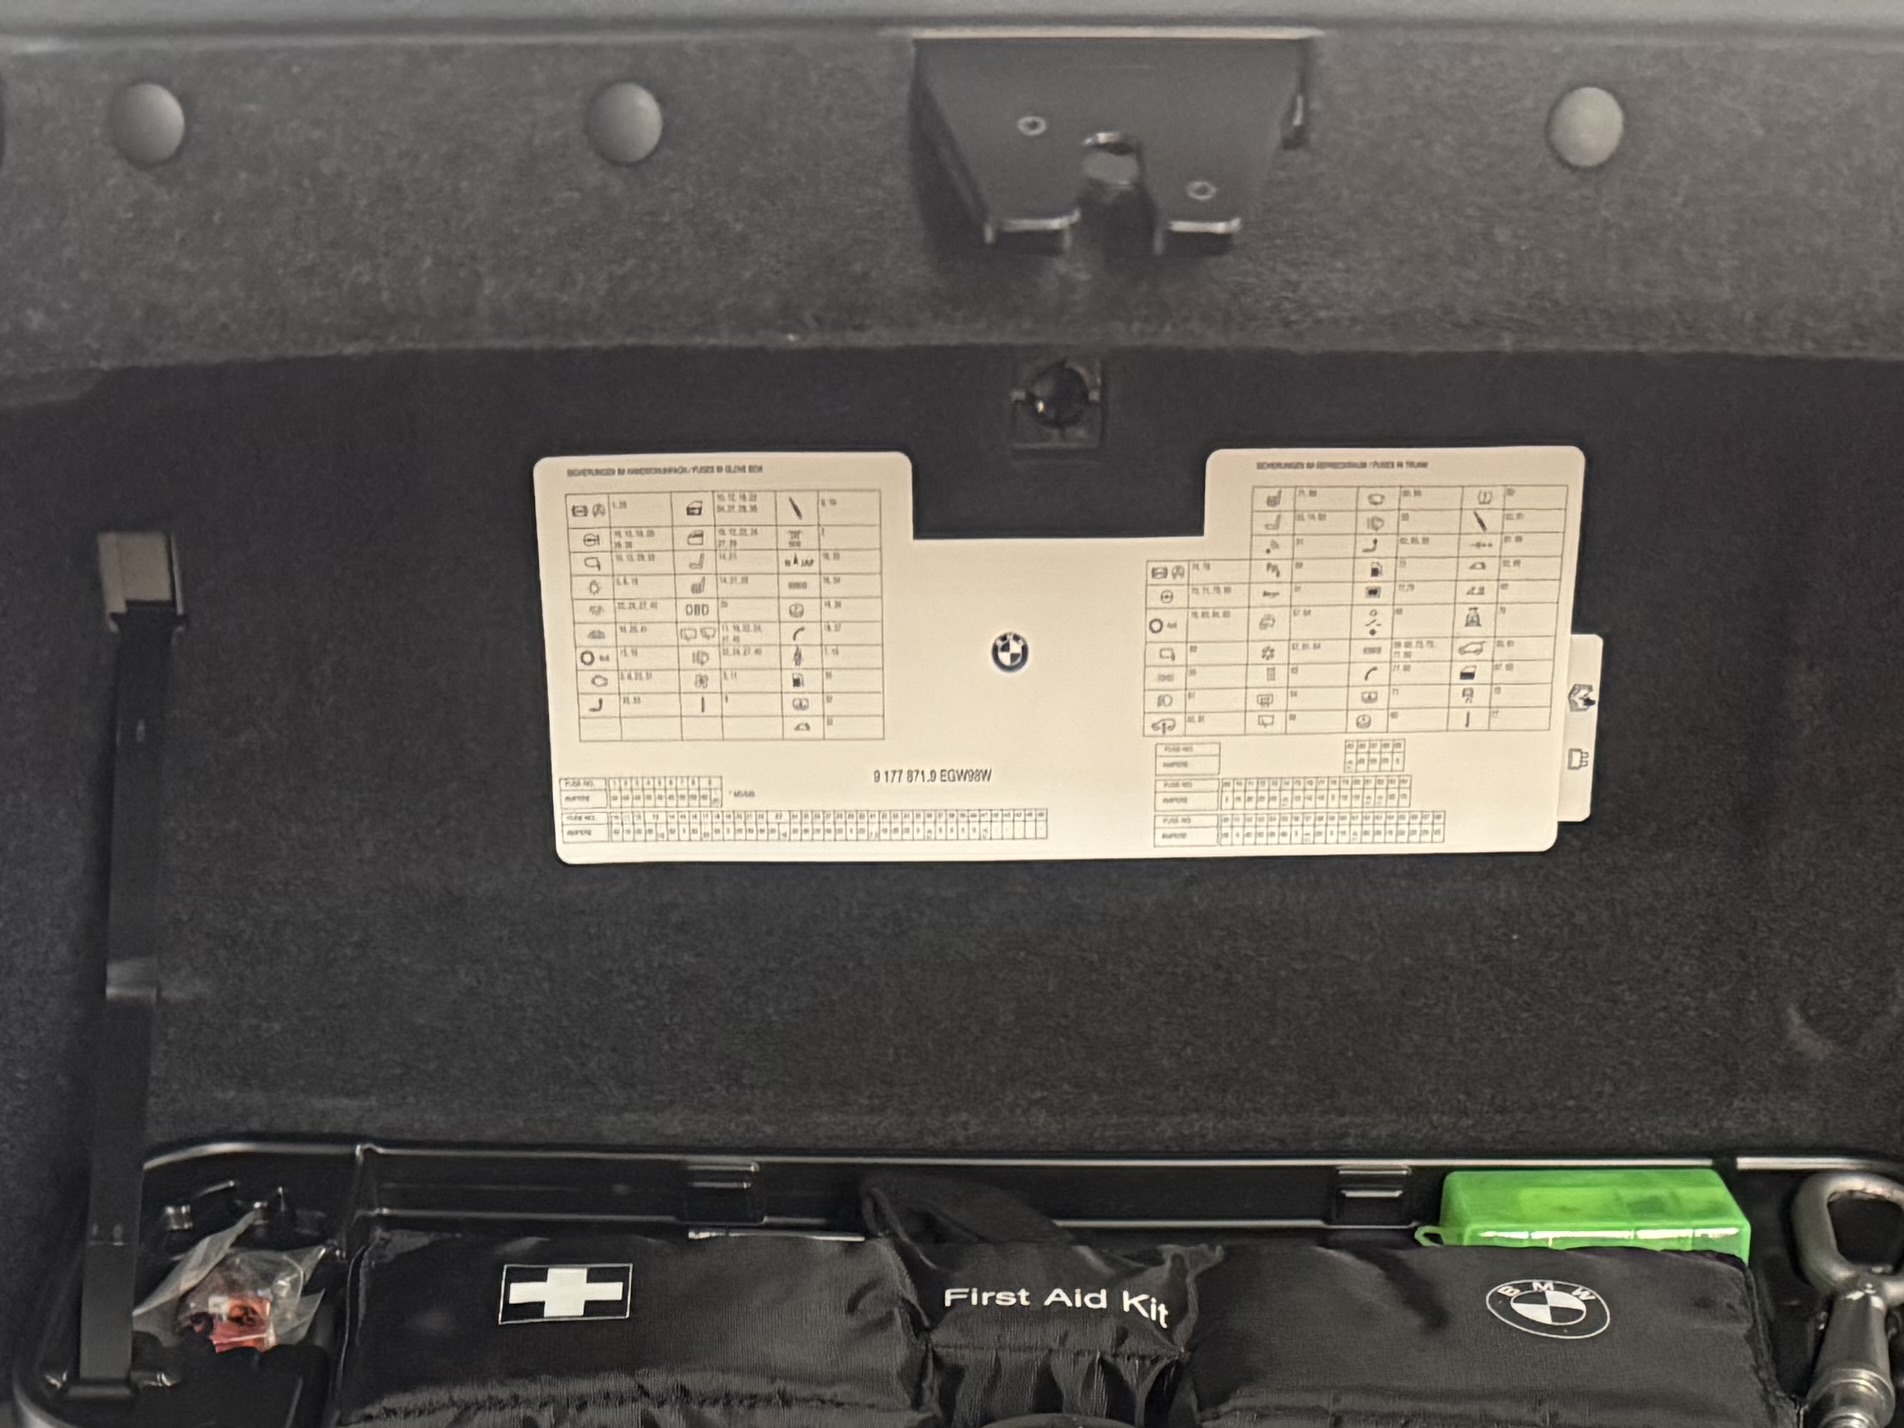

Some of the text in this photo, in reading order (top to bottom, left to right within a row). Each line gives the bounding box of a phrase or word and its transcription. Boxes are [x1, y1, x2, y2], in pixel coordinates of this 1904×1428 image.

[884, 769, 903, 783] 177
[944, 1288, 1169, 1329] First Aid Kit
